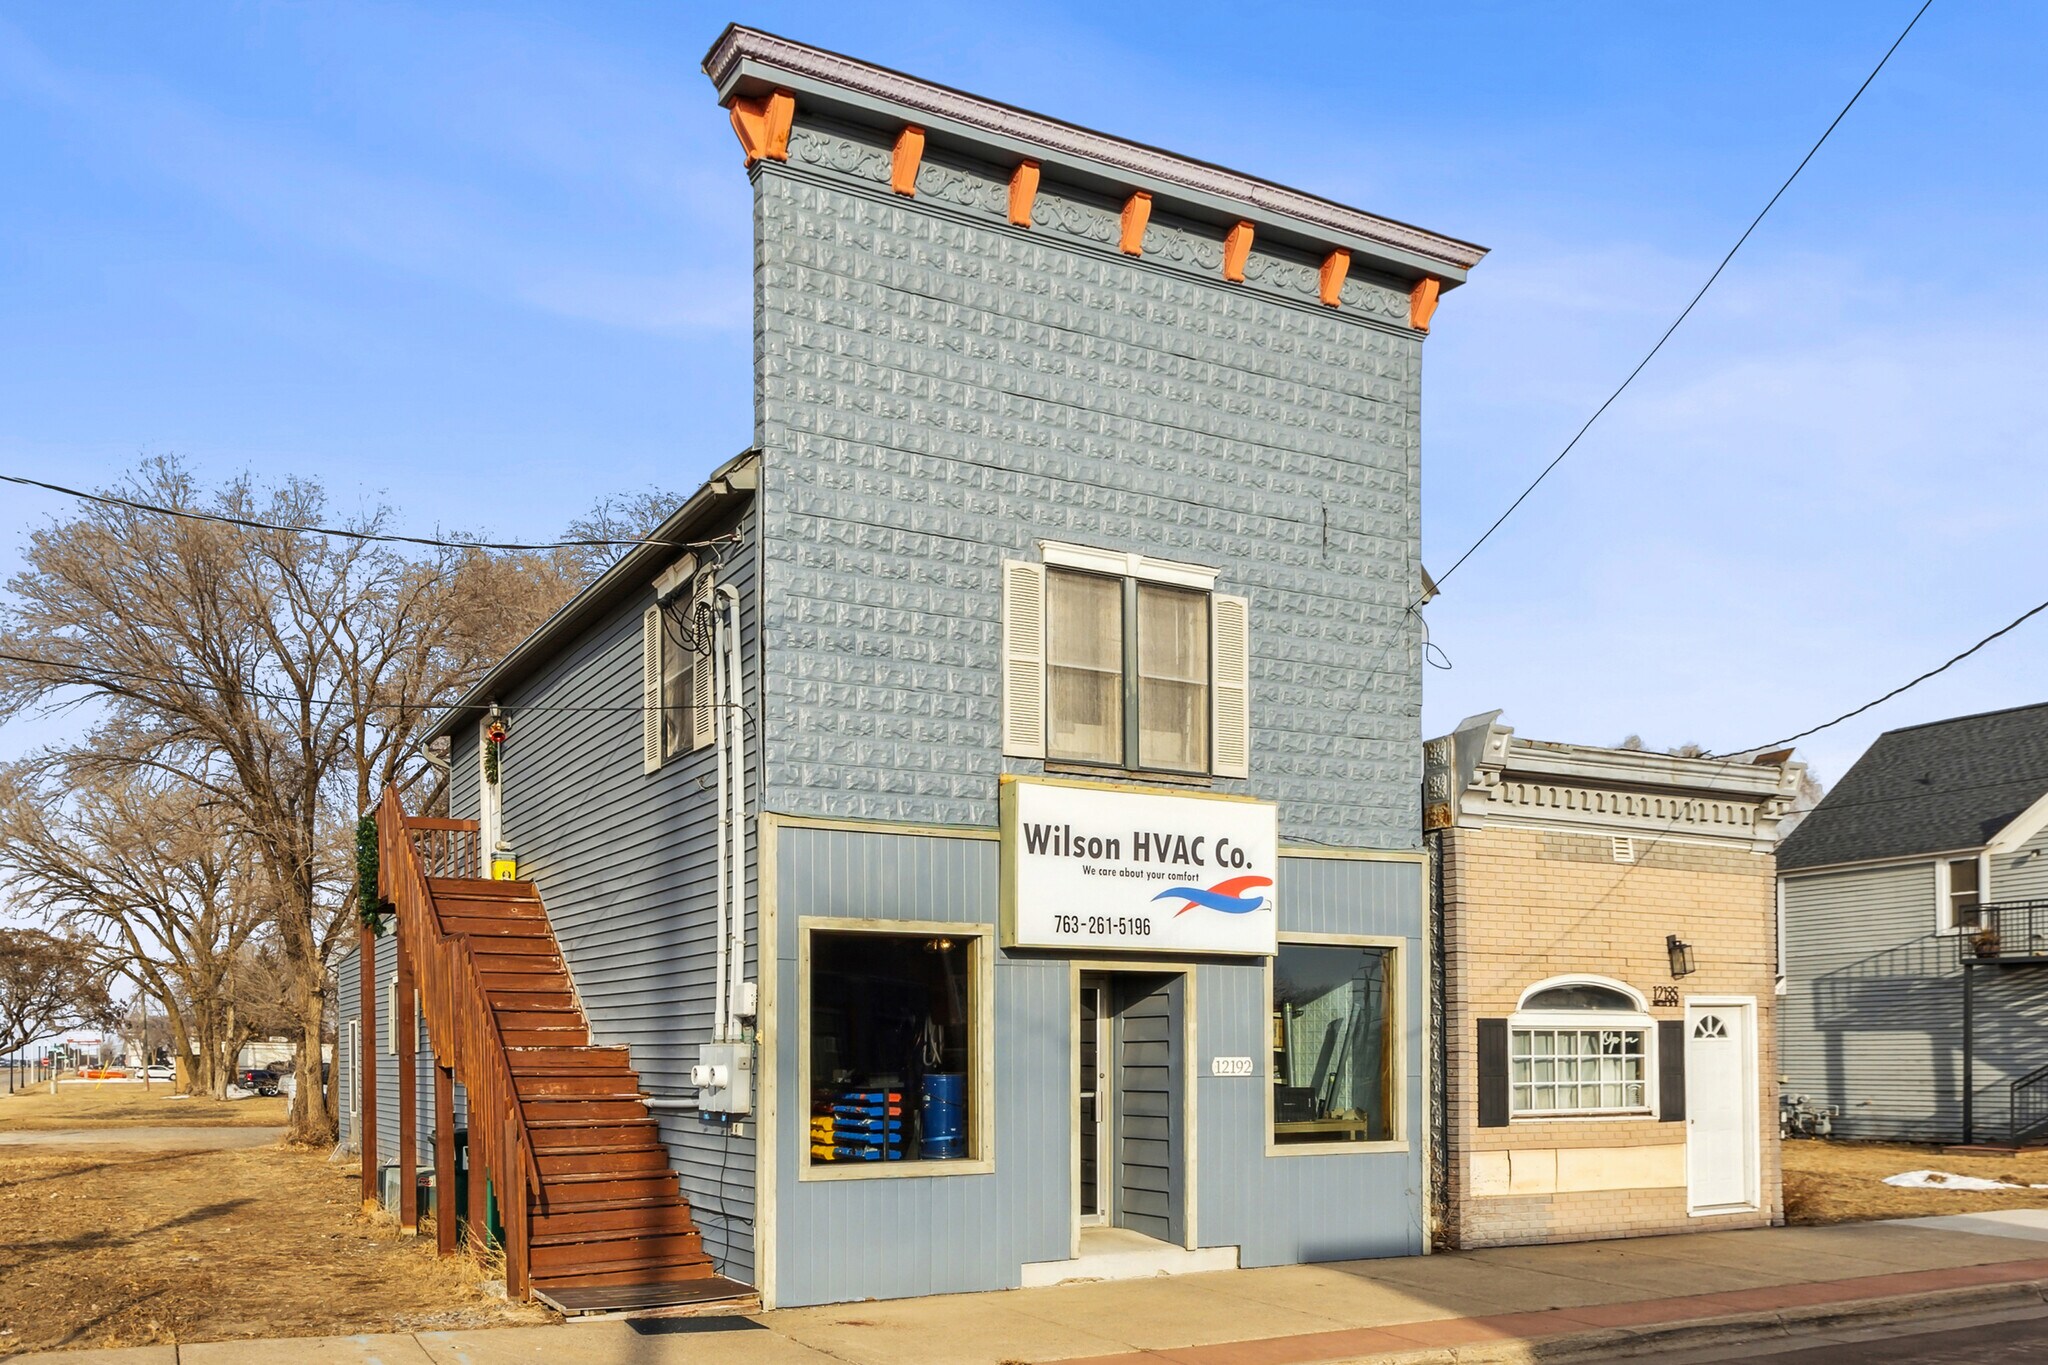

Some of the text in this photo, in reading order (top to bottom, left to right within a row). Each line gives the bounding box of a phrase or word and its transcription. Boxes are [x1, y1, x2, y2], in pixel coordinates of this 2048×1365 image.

[1023, 822, 1253, 869] Wilson HVAC Co.
[1082, 864, 1199, 882] We care about your comfort
[1054, 914, 1151, 936] 763-261-5196
[1603, 1031, 1639, 1054] Opn
[1215, 1060, 1252, 1074] 12192
